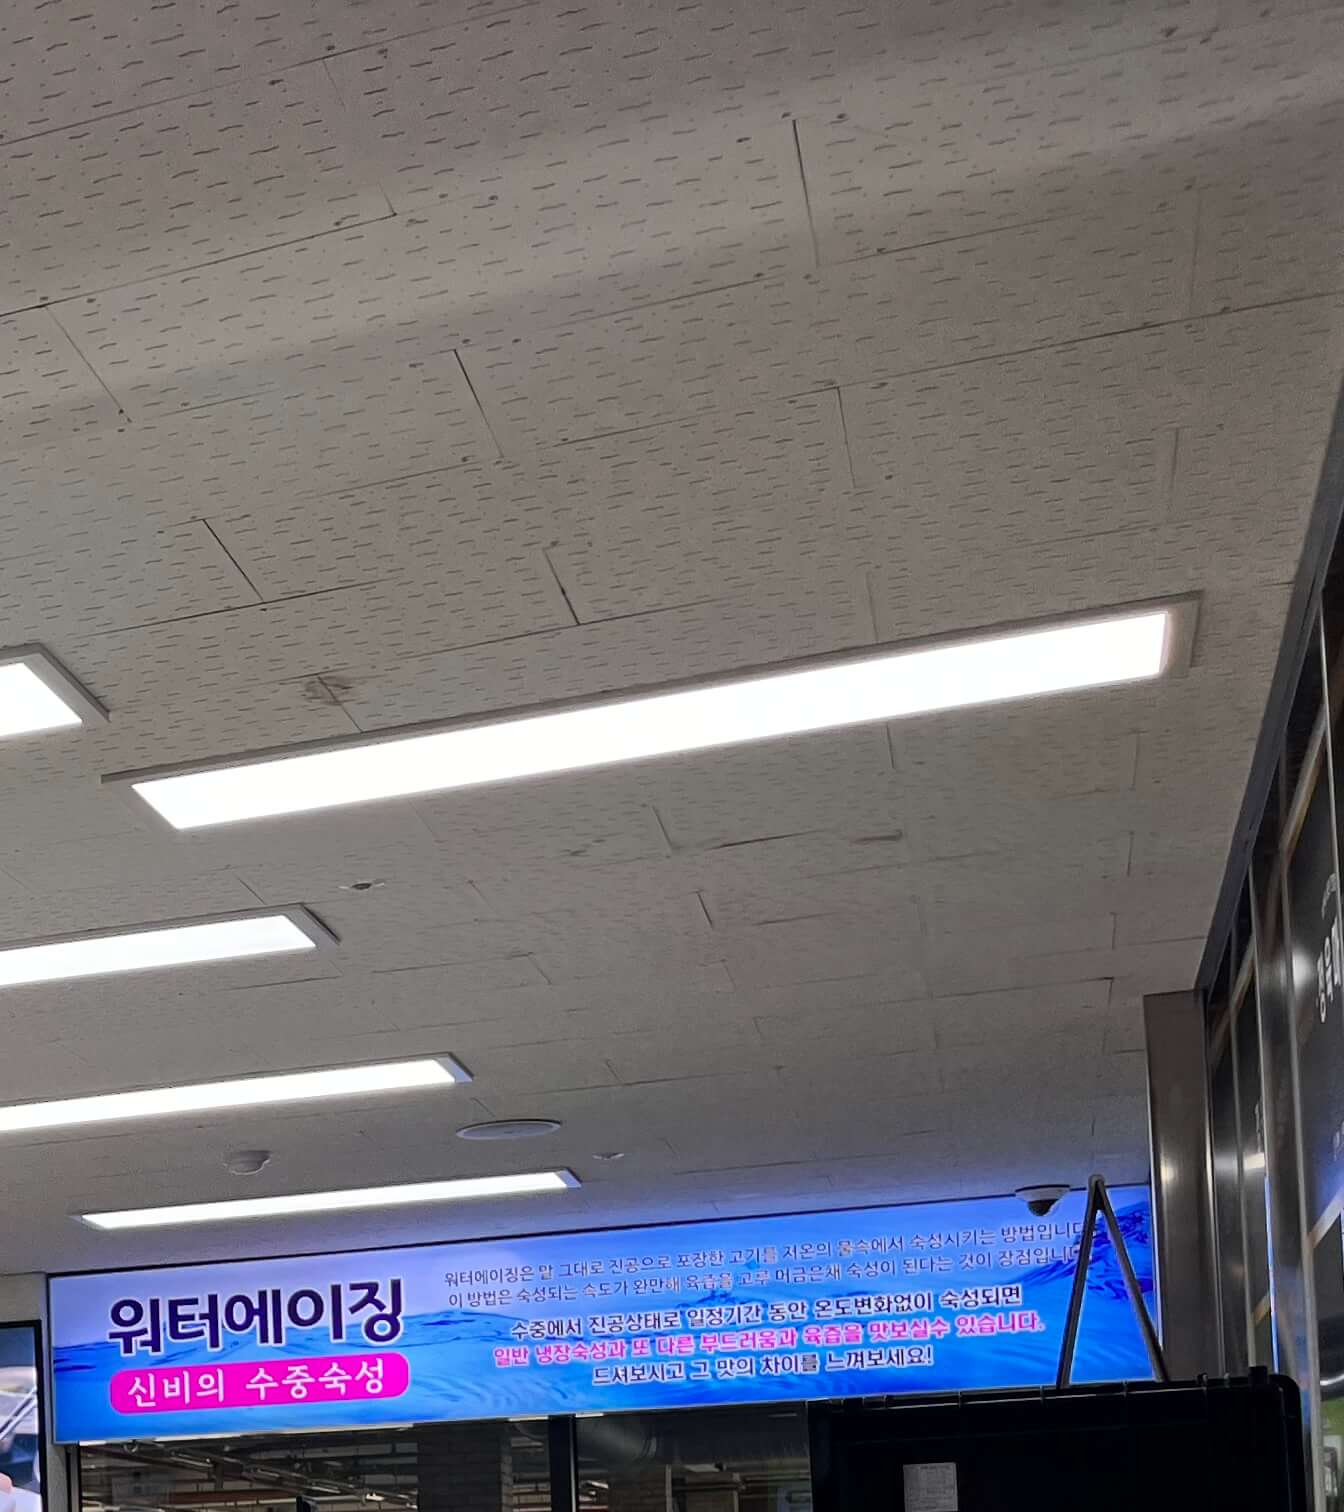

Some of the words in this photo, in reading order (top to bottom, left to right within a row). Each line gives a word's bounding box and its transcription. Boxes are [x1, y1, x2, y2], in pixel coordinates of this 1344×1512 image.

[444, 1264, 534, 1287] 워터에이징은
[559, 1260, 604, 1277] 그대로
[609, 1255, 670, 1273] 진공으로
[676, 1250, 723, 1268] 포장한
[729, 1246, 776, 1264] 고기를
[783, 1241, 831, 1260] 저온의
[837, 1236, 903, 1256] 물속에서
[910, 1229, 995, 1249] 숙성시키는
[449, 1294, 462, 1308] 이
[467, 1289, 511, 1307] 방법은
[517, 1284, 577, 1303] 숙성되는
[583, 1280, 627, 1297] 속도가
[847, 1260, 895, 1279] 숙성이
[903, 1255, 953, 1275] 된다는
[960, 1251, 991, 1269] 것이
[109, 1278, 404, 1355] 워터에이징
[494, 1346, 529, 1367] 일반
[536, 1339, 626, 1364] 냉장숙성과
[632, 1338, 649, 1357] 또
[658, 1334, 694, 1355] 다른
[702, 1326, 796, 1352] 부드러움과
[804, 1323, 862, 1346] 육즙을
[869, 1318, 949, 1342] 맛보실수
[957, 1311, 1044, 1335] 있습니다.
[512, 1318, 582, 1340] 수중에서
[589, 1311, 680, 1335] 진공상태로
[688, 1305, 761, 1327] 일정기간
[768, 1301, 806, 1321] 동안
[814, 1293, 933, 1318] 온도변화없이
[940, 1284, 1022, 1309] 숙성되면
[128, 1368, 224, 1407] 신비의
[246, 1358, 385, 1401] 수중숙성
[593, 1362, 682, 1386] 드셔보시고
[691, 1360, 710, 1378] 그
[717, 1358, 754, 1380] 맛의
[762, 1350, 818, 1375] 차이를
[826, 1346, 933, 1371] 느껴보세요!
